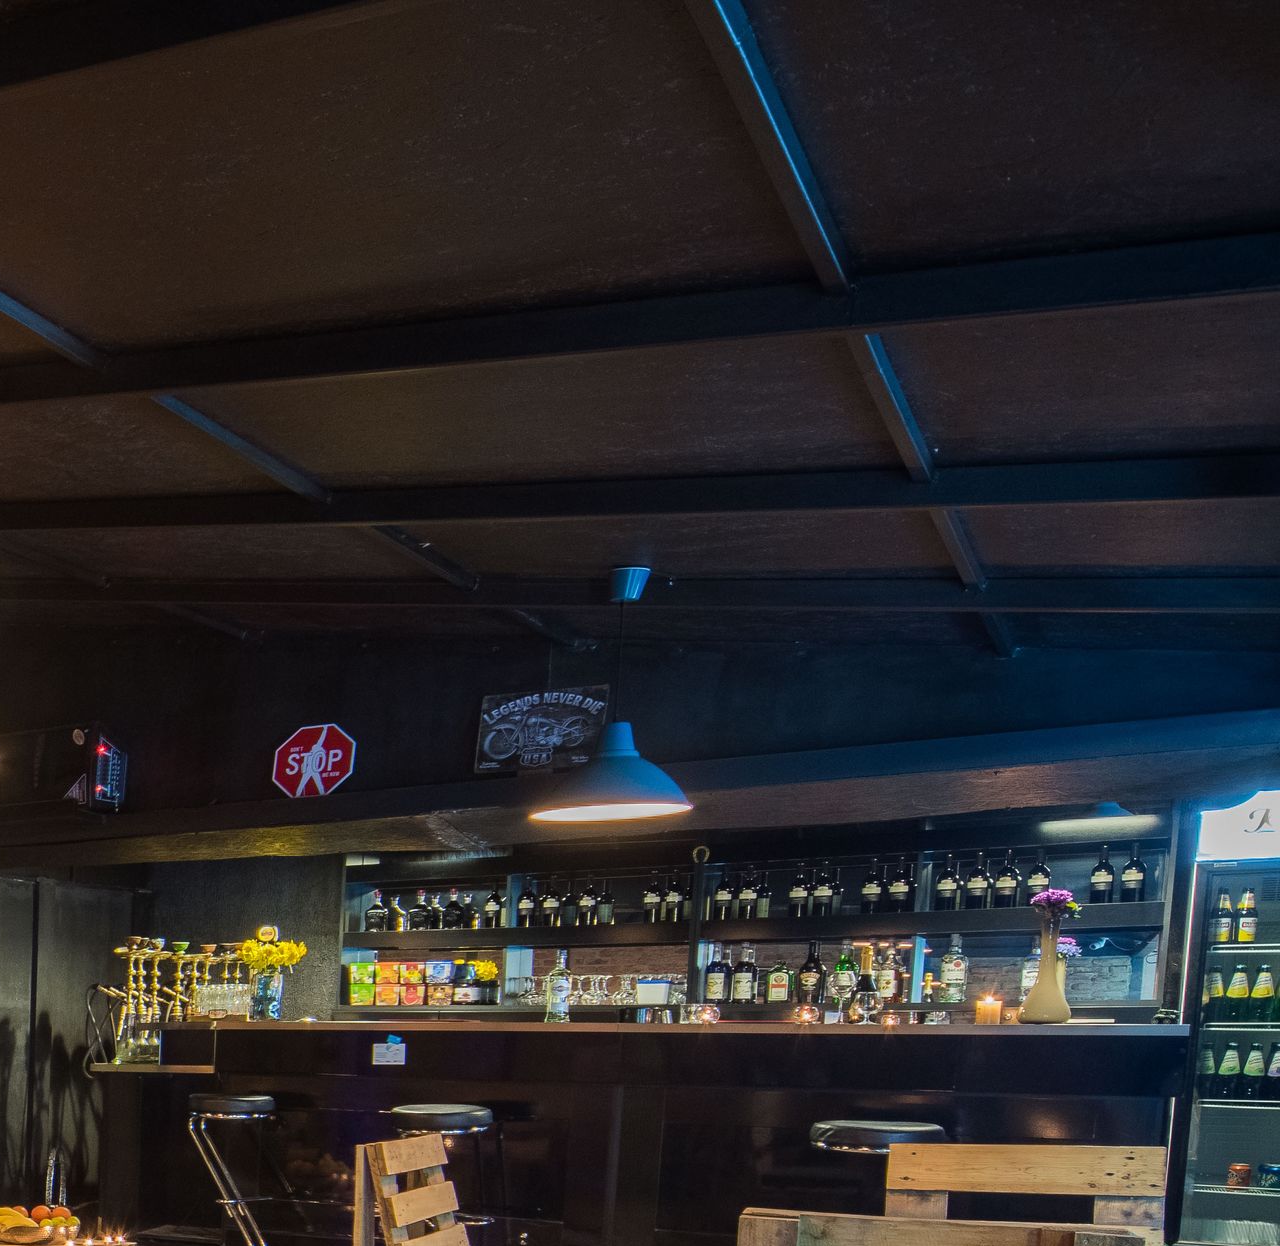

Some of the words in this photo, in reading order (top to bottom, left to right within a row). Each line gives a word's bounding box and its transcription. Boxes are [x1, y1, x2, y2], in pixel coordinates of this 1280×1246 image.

[483, 694, 540, 725] LEGENDS
[543, 692, 583, 707] NEVER
[581, 698, 605, 715] DIE
[285, 749, 343, 775] STOP
[524, 753, 548, 764] USA
